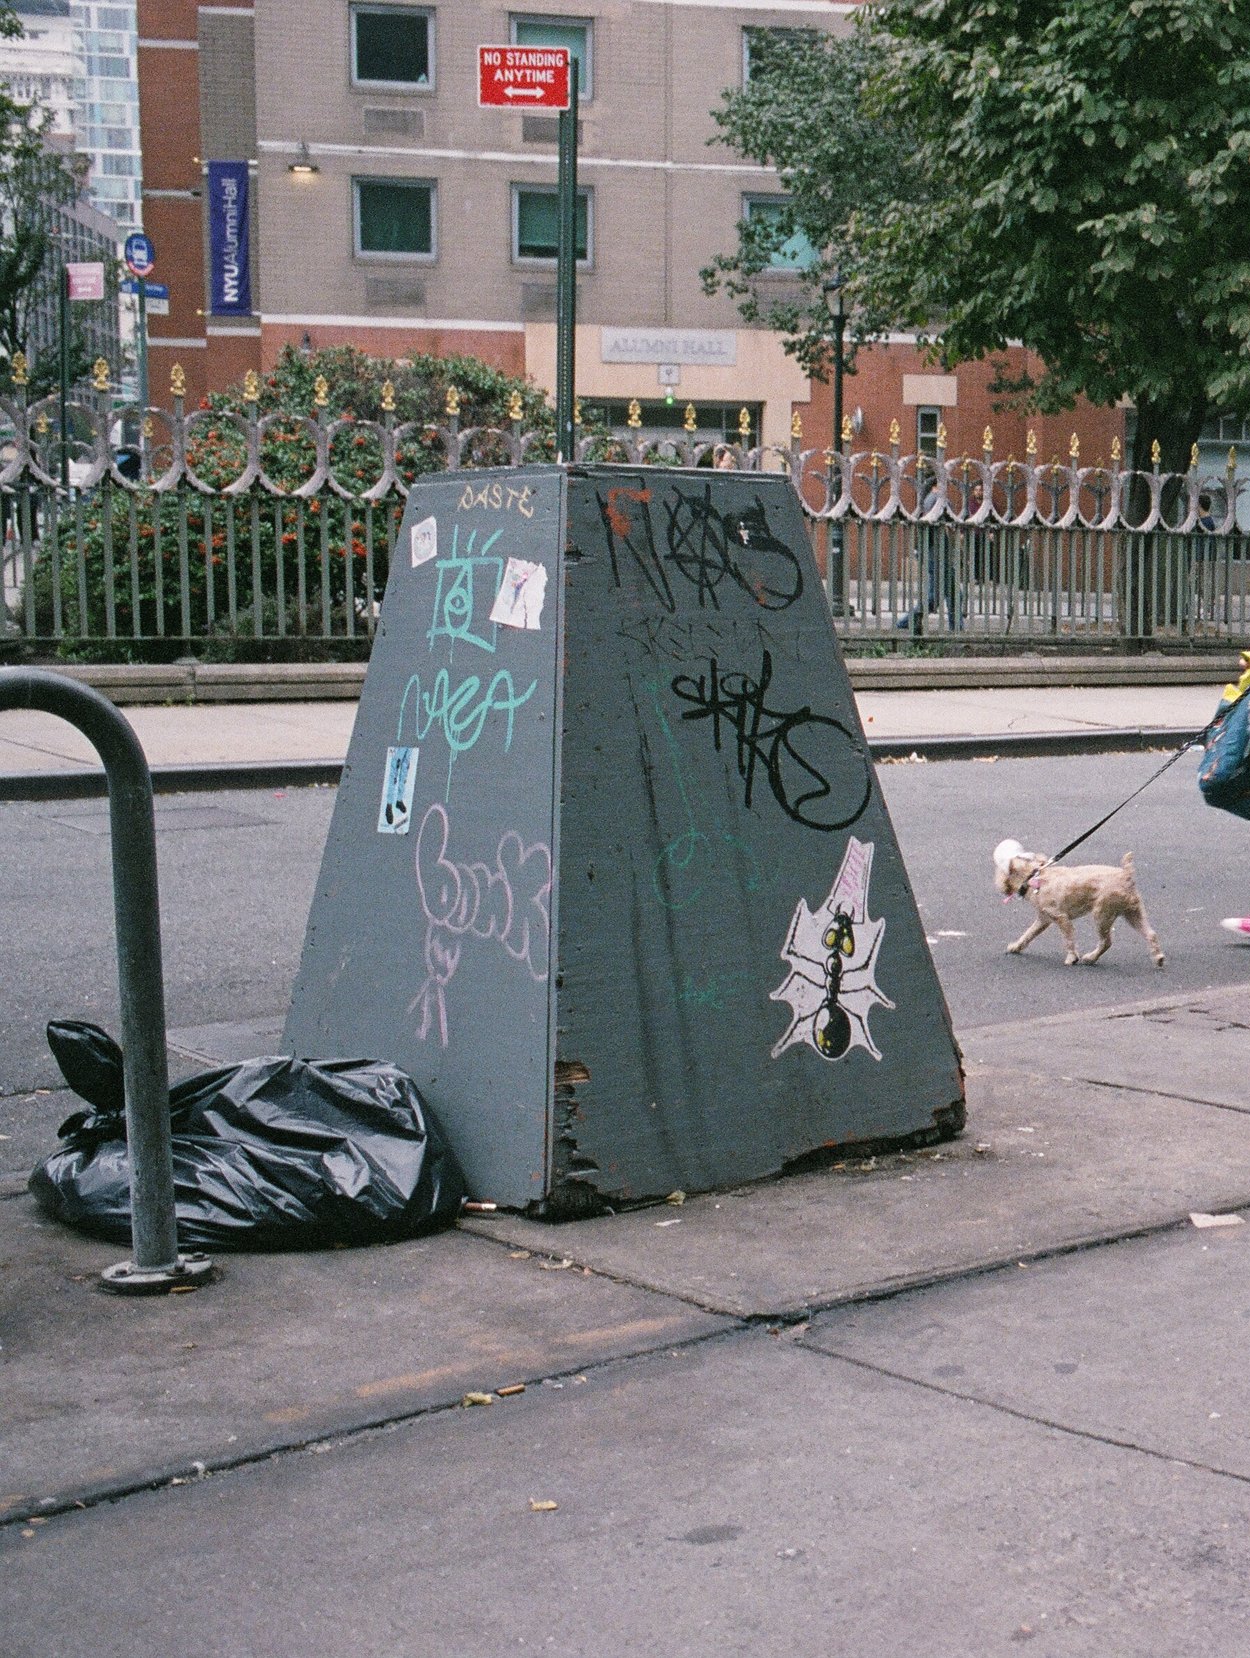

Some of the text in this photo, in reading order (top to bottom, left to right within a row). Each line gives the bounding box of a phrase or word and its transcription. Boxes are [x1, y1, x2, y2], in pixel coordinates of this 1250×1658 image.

[483, 51, 564, 67] NO STANDING
[494, 68, 555, 84] ANYTIME
[609, 337, 729, 356] ALUMNI HALL
